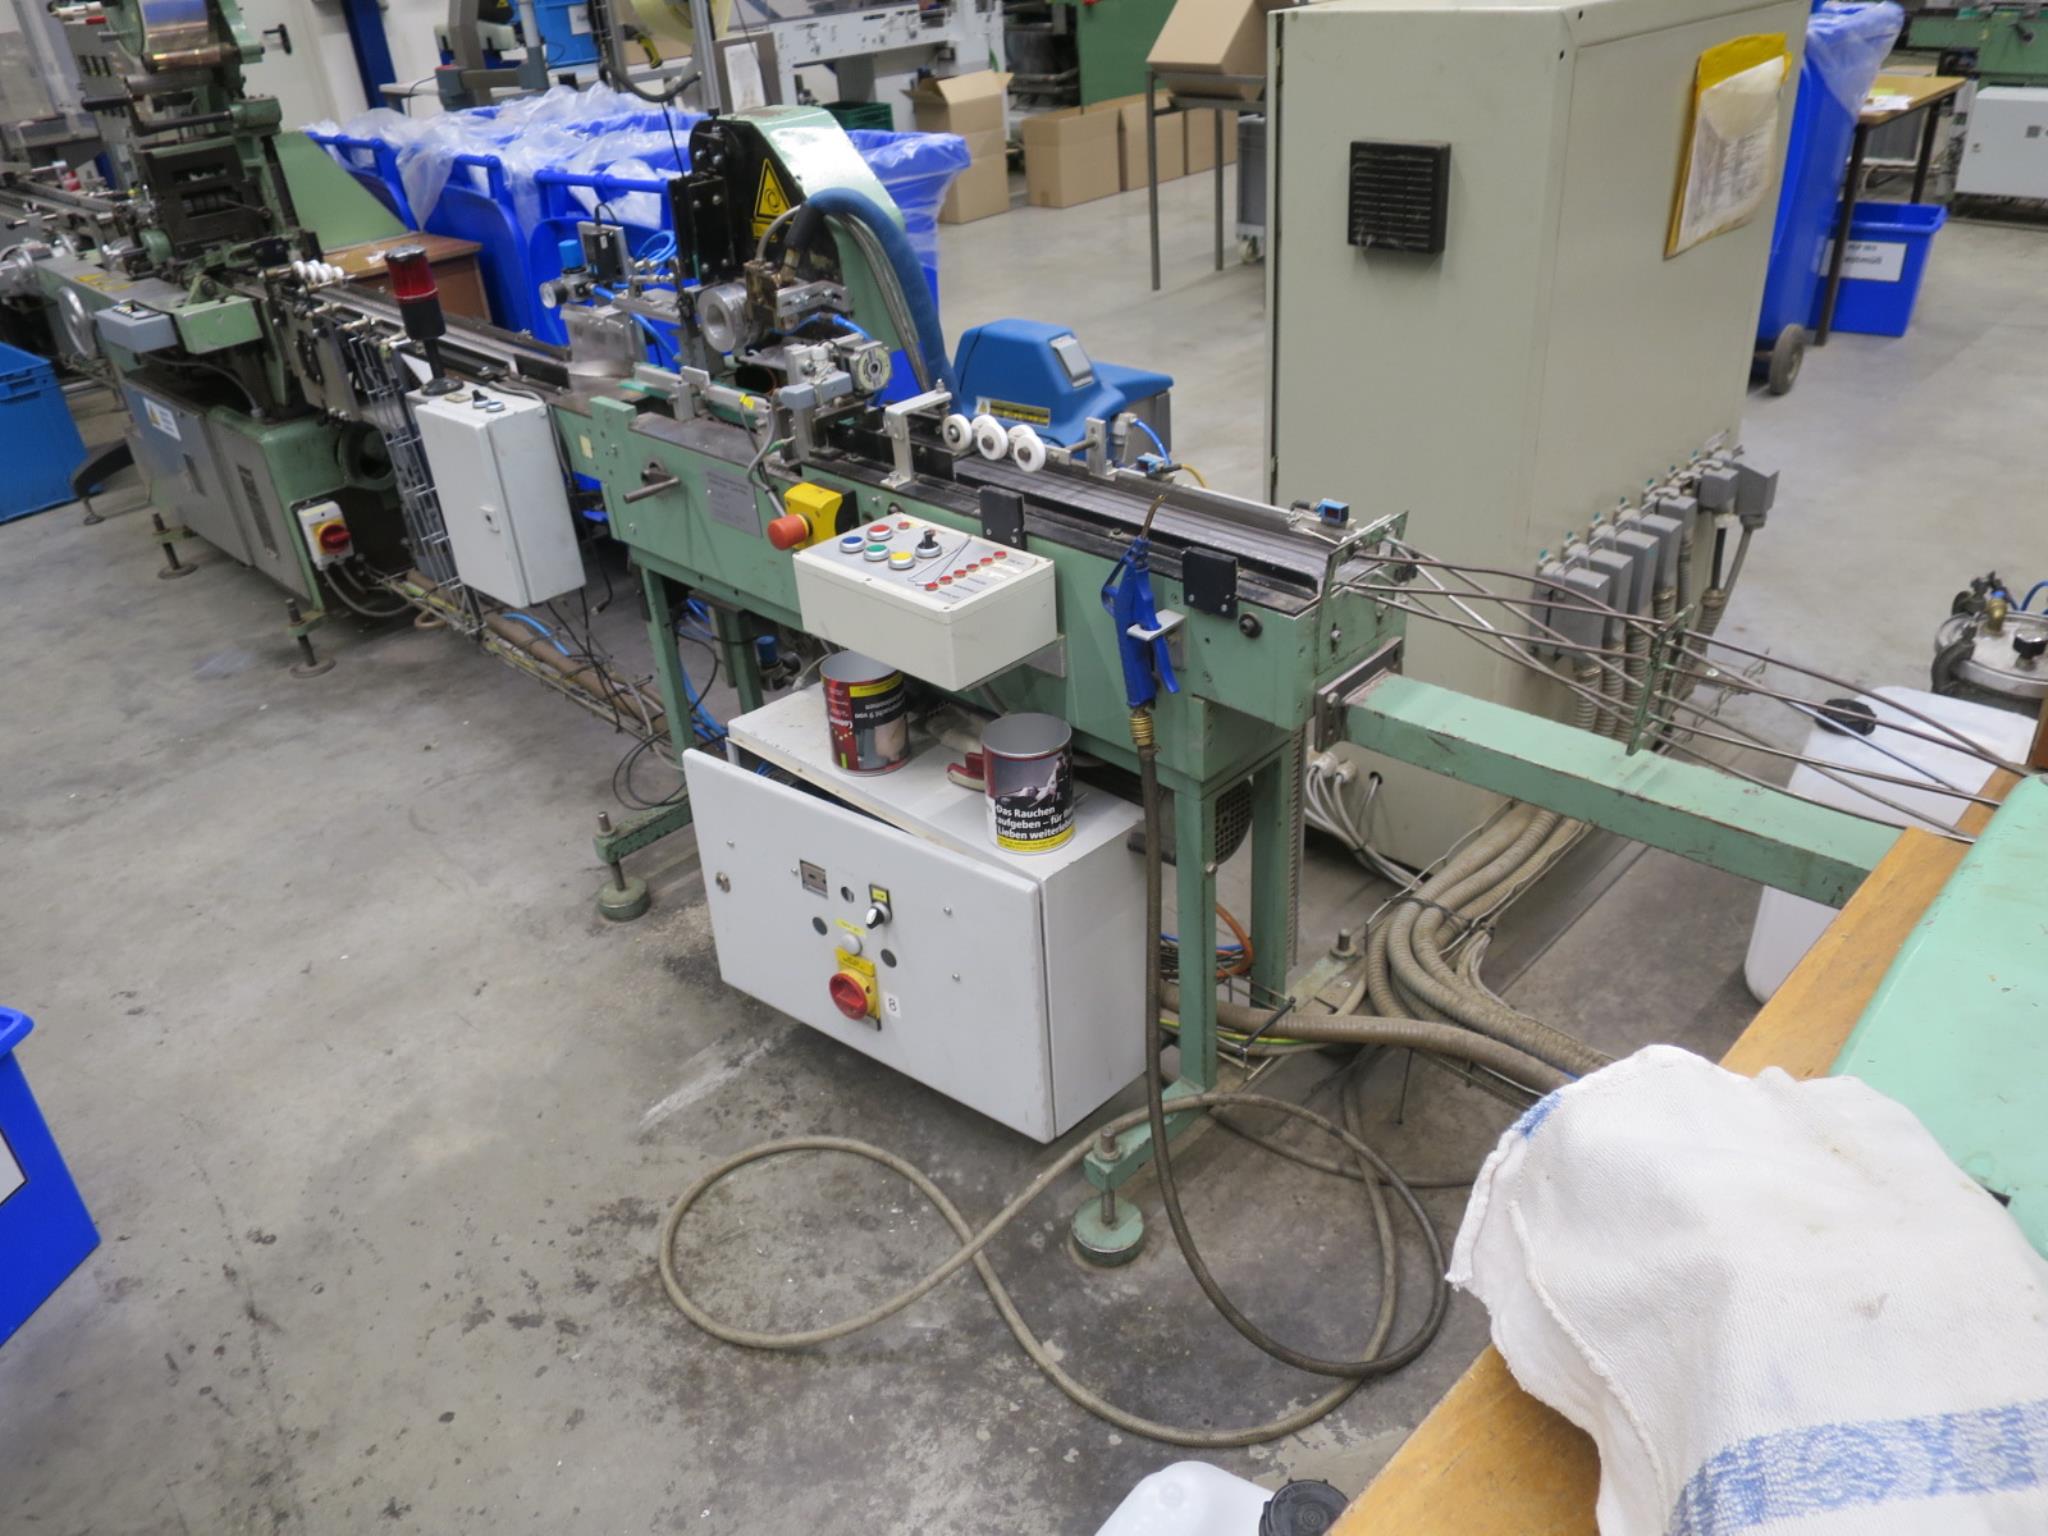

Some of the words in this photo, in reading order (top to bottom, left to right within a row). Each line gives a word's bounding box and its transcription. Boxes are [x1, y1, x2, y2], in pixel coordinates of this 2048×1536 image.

[996, 804, 1012, 816] Das
[1014, 806, 1055, 818] Rauchen
[997, 817, 1041, 830] aufgeben
[1050, 814, 1062, 824] für
